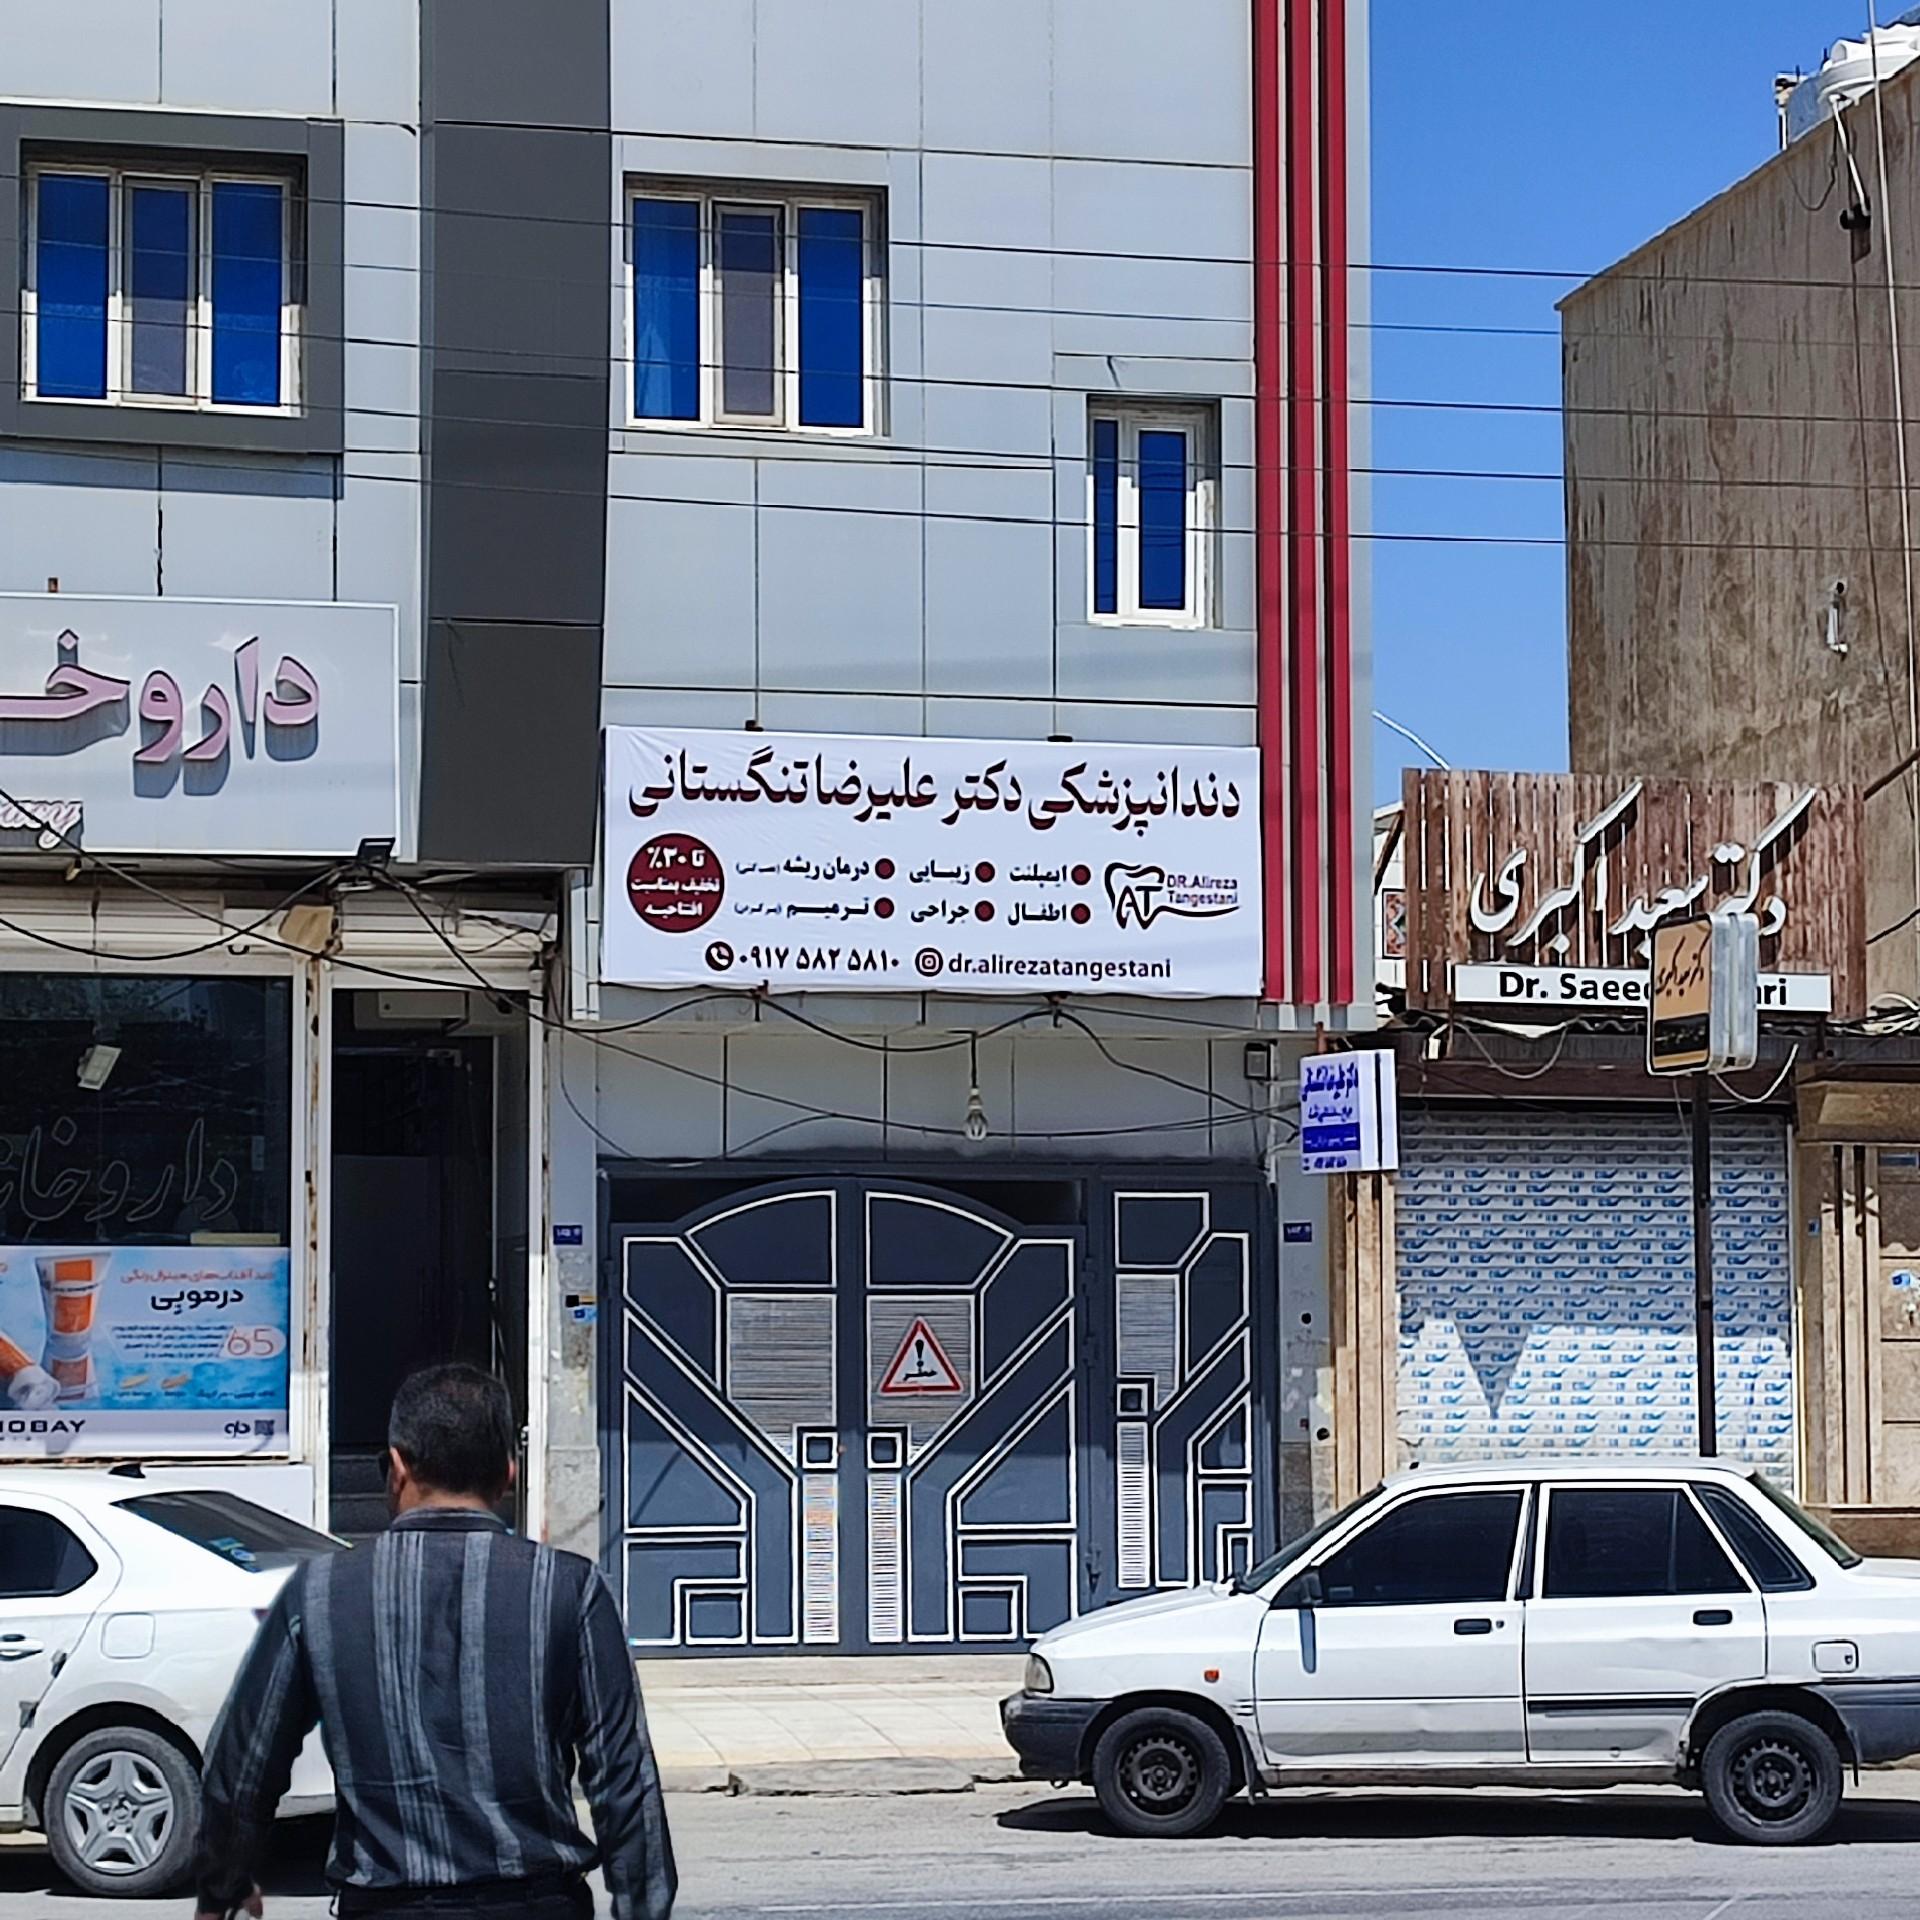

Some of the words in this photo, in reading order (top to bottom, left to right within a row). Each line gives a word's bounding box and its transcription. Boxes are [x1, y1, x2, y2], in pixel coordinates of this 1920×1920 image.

[0, 628, 319, 770] داروخ
[629, 745, 809, 818] تنگستانی
[815, 752, 937, 823] علیرضا
[941, 759, 1022, 826] دکتر
[1028, 762, 1240, 837] دندانپزشکی
[692, 849, 706, 868] تا
[783, 854, 820, 880] ریشه
[822, 856, 870, 881] درمان
[1470, 779, 1644, 955] اکبری
[1713, 787, 1817, 936] دکت
[909, 860, 970, 885] زیبایی
[1167, 874, 1238, 889] DR.Alireza
[681, 877, 720, 895] تخفیف
[1167, 890, 1238, 907] Tangestani
[787, 897, 870, 920] ترمیم
[910, 900, 969, 924] جراحی
[1007, 902, 1067, 926] اطفال
[740, 945, 789, 969] ۰۹۱۷
[848, 948, 900, 971] ۵۸۱۰
[949, 953, 1171, 981] dr.alirezatangestani
[1499, 971, 1549, 999] Dr.
[227, 1328, 275, 1356] 65
